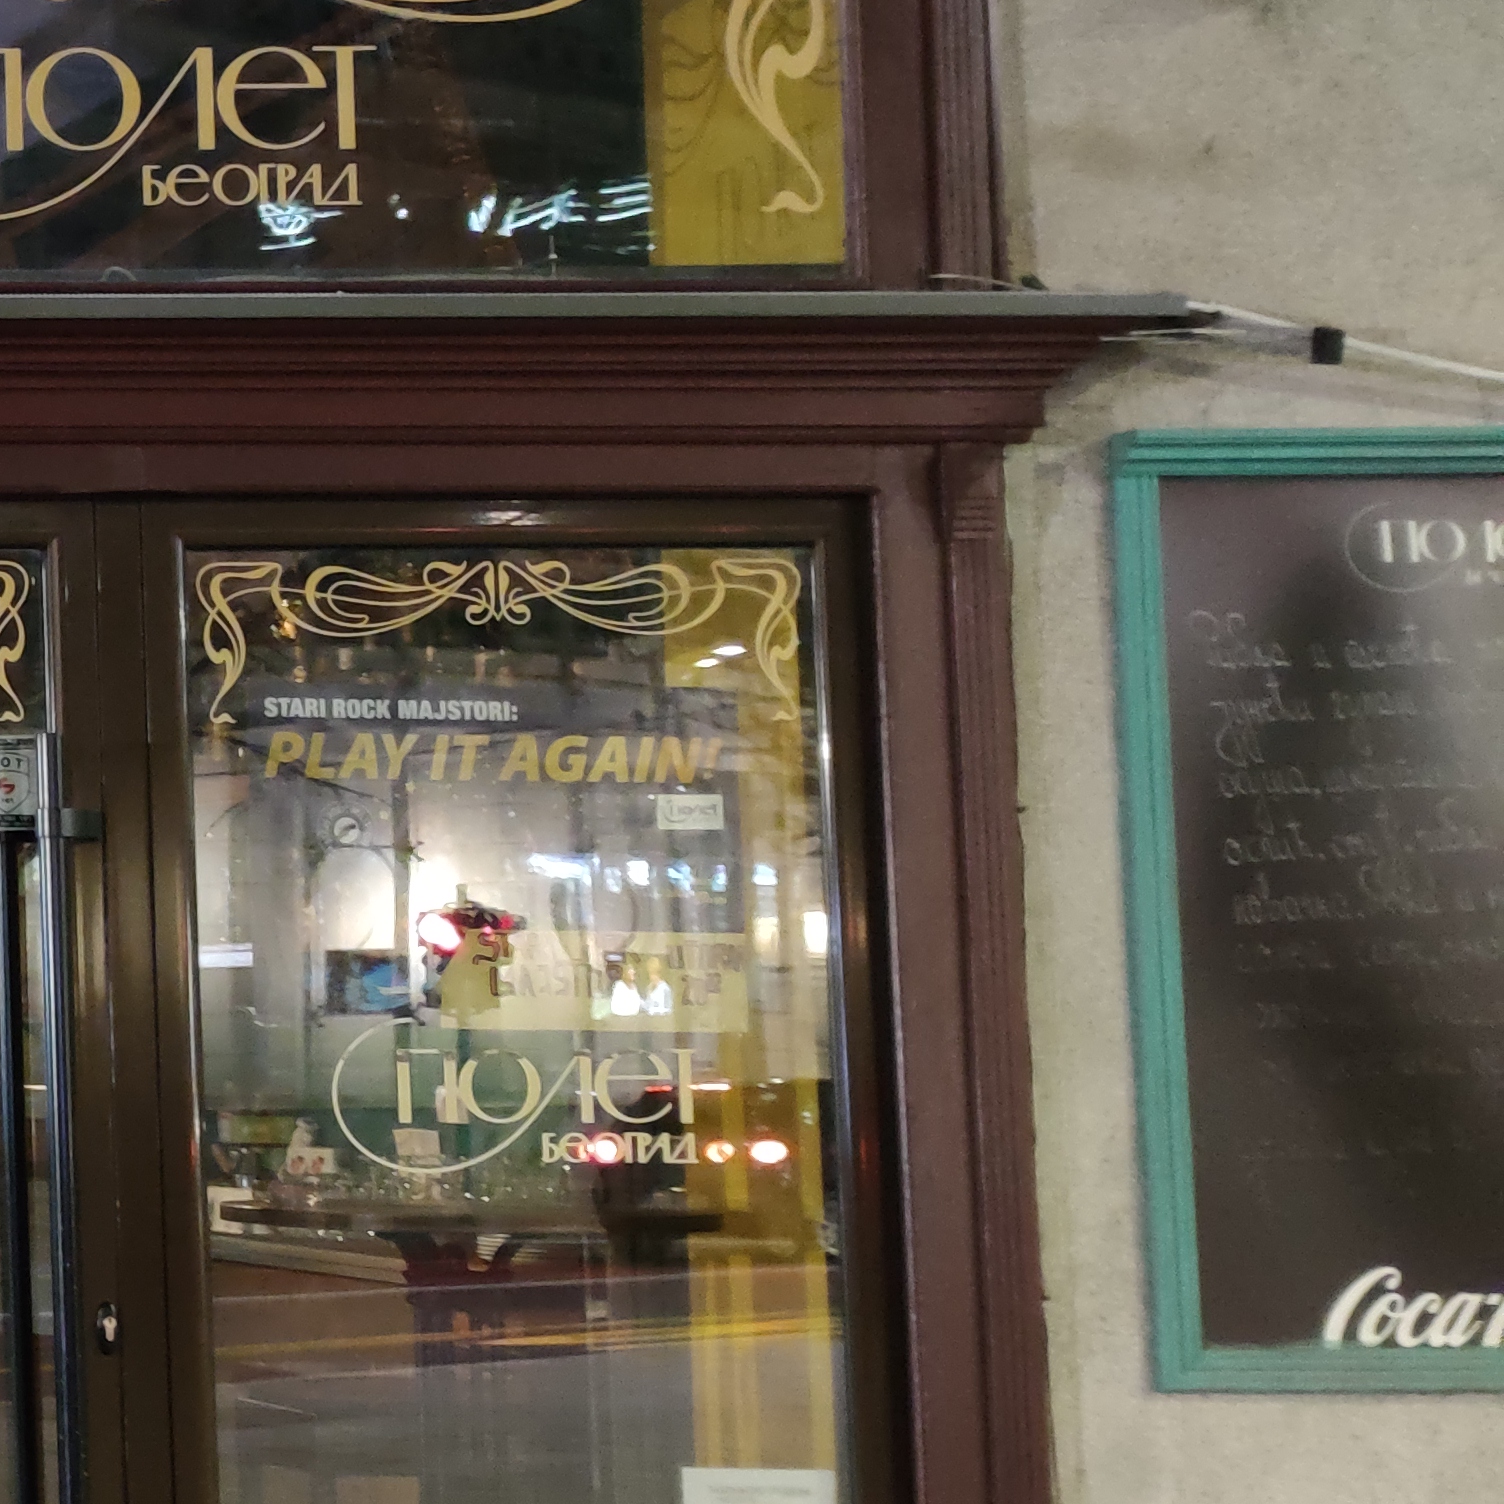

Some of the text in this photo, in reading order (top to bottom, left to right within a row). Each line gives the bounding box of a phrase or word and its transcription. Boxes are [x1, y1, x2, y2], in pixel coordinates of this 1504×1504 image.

[264, 697, 518, 722] STARI ROCK MAJSTORI:
[264, 732, 723, 784] PLAY IT AGAIN!
